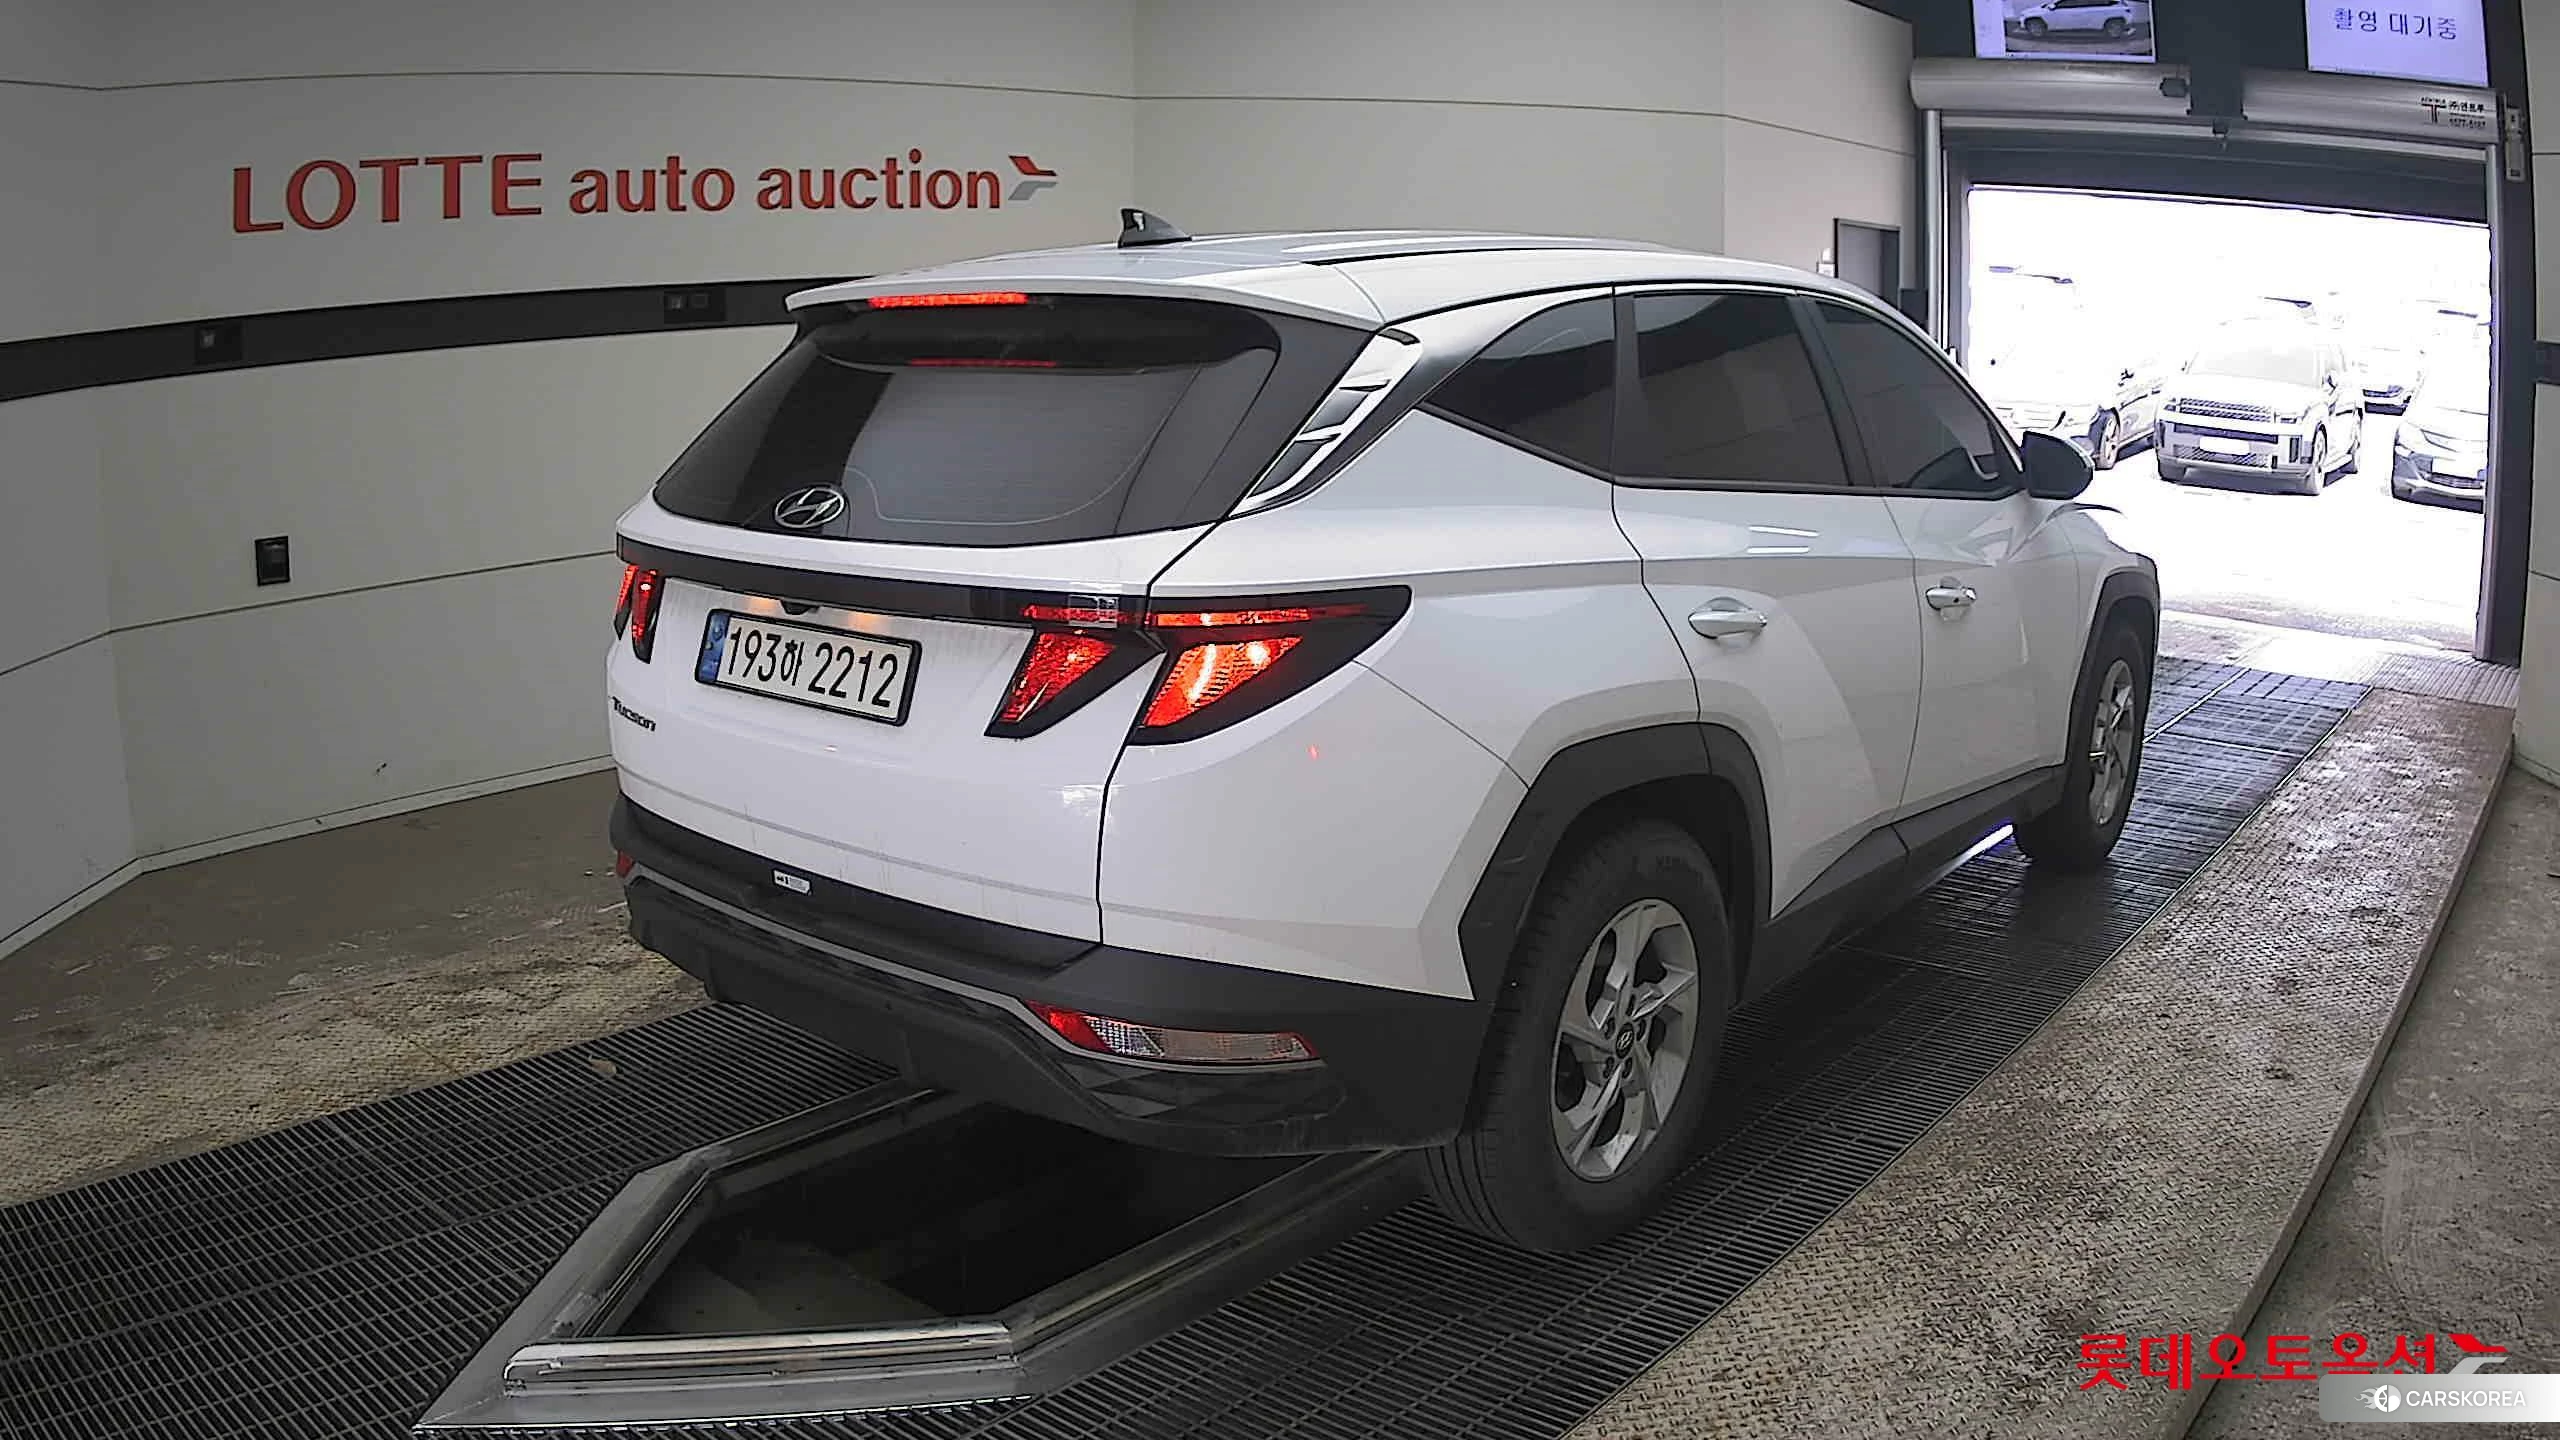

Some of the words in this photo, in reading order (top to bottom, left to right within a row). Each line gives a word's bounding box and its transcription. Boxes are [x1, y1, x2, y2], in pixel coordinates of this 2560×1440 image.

[2334, 8, 2377, 32] 촬영
[233, 152, 543, 233] LOTTE
[568, 155, 735, 214] auto
[756, 147, 1002, 210] auction
[728, 627, 805, 686] 193하
[807, 642, 898, 707] 2212
